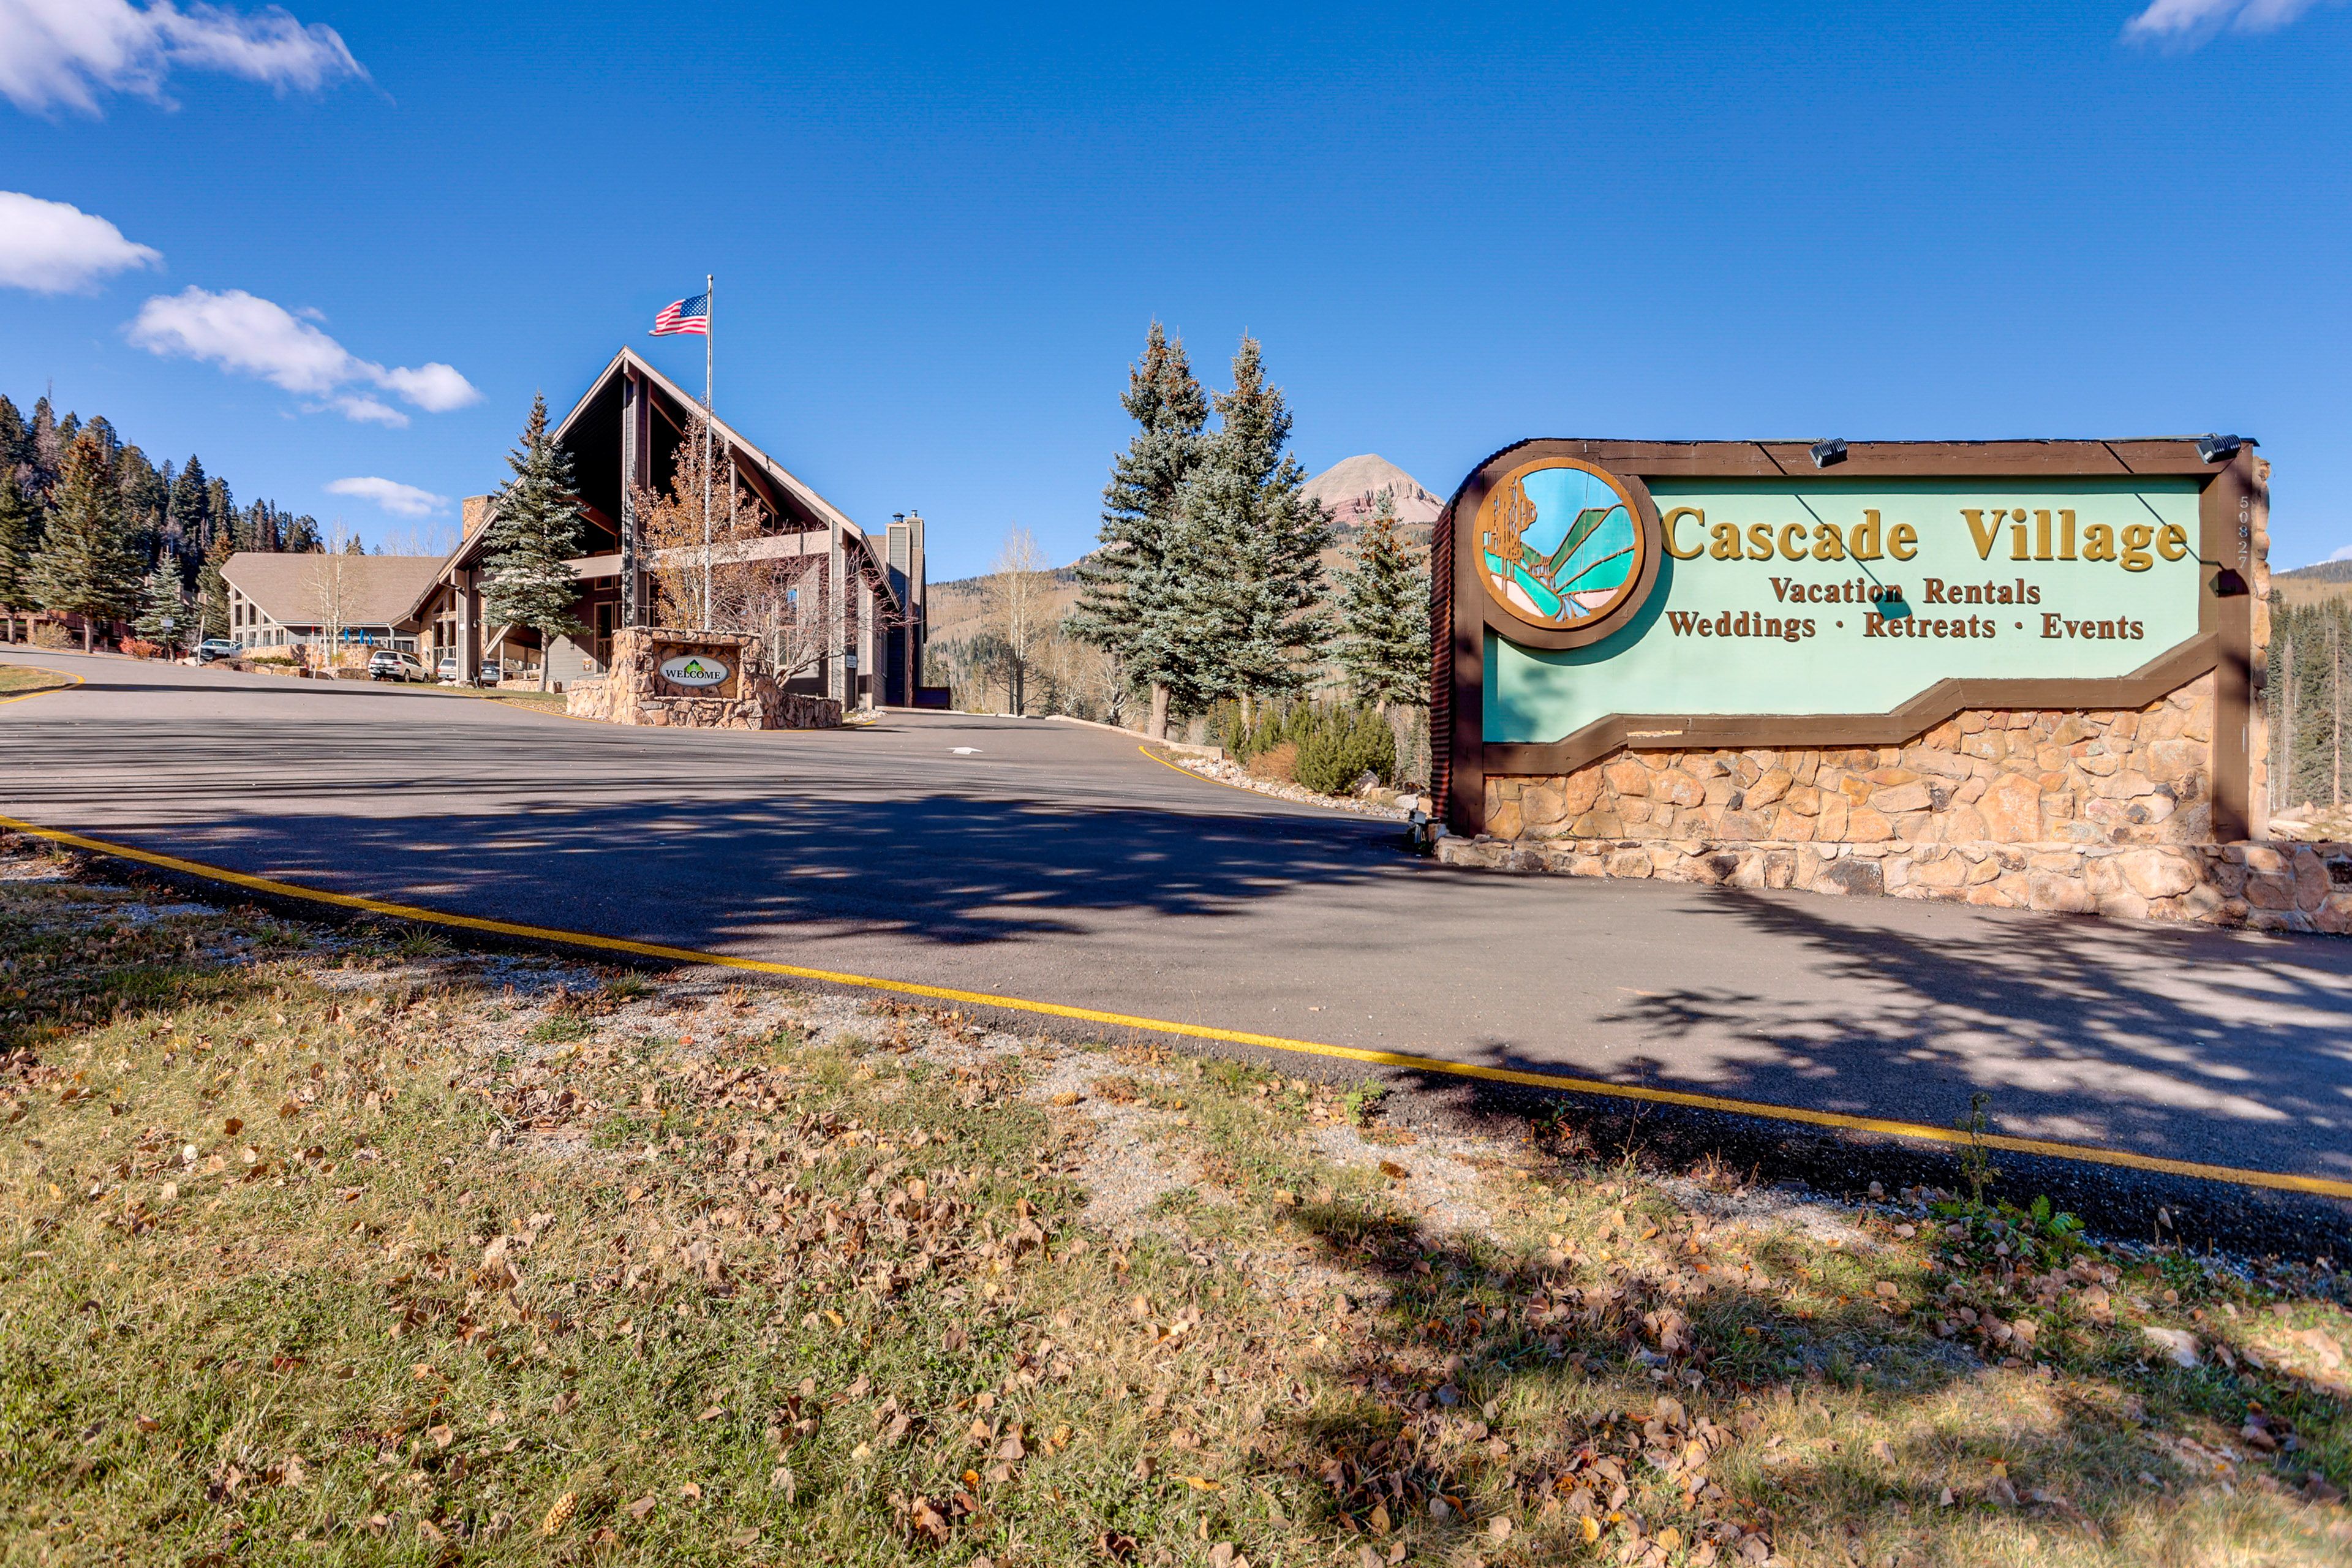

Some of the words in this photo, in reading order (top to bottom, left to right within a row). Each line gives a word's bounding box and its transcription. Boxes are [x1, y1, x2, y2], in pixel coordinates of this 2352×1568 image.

[1661, 507, 1918, 562] Cascade
[1959, 508, 2187, 573] Village
[2238, 496, 2248, 569] 50827
[1768, 577, 1904, 604] Vacation
[1922, 578, 2041, 605] Rentals
[1665, 611, 1816, 643] Weddings
[1863, 612, 1996, 638] Retreats
[2040, 612, 2144, 639] Events
[666, 669, 720, 679] WELCOME
